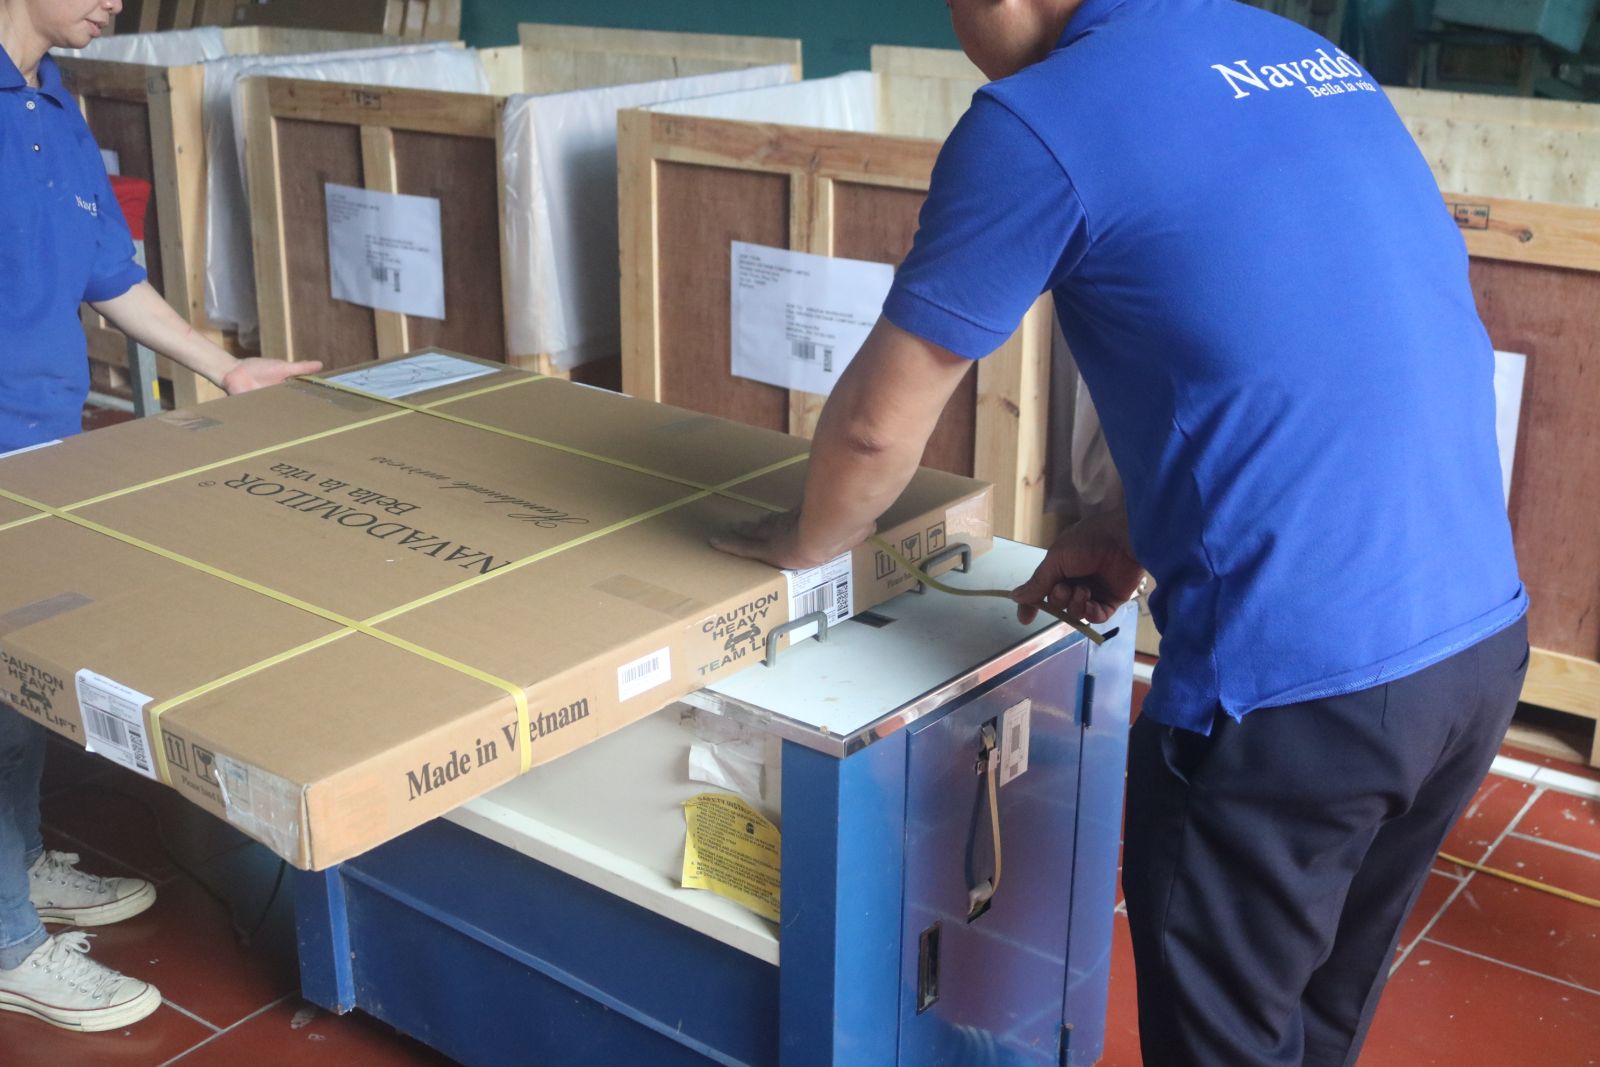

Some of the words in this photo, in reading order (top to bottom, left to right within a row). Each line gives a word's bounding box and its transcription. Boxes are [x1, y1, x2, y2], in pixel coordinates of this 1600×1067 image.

[1210, 48, 1362, 99] Navado
[1305, 83, 1345, 98] Bella
[1340, 80, 1358, 92] la
[1355, 80, 1377, 92] vita
[269, 462, 317, 483] vita
[318, 477, 351, 493] la
[348, 487, 422, 516] Bella
[438, 481, 590, 529] Handmade
[224, 472, 512, 575] NAVADOMILOR
[702, 590, 780, 634] CAUTION
[712, 606, 769, 641] HEAVY
[698, 646, 746, 676] TEAM
[8, 665, 57, 697] HEAVY
[405, 750, 472, 801] Made
[476, 737, 499, 768] in
[501, 696, 591, 752] Vetnam
